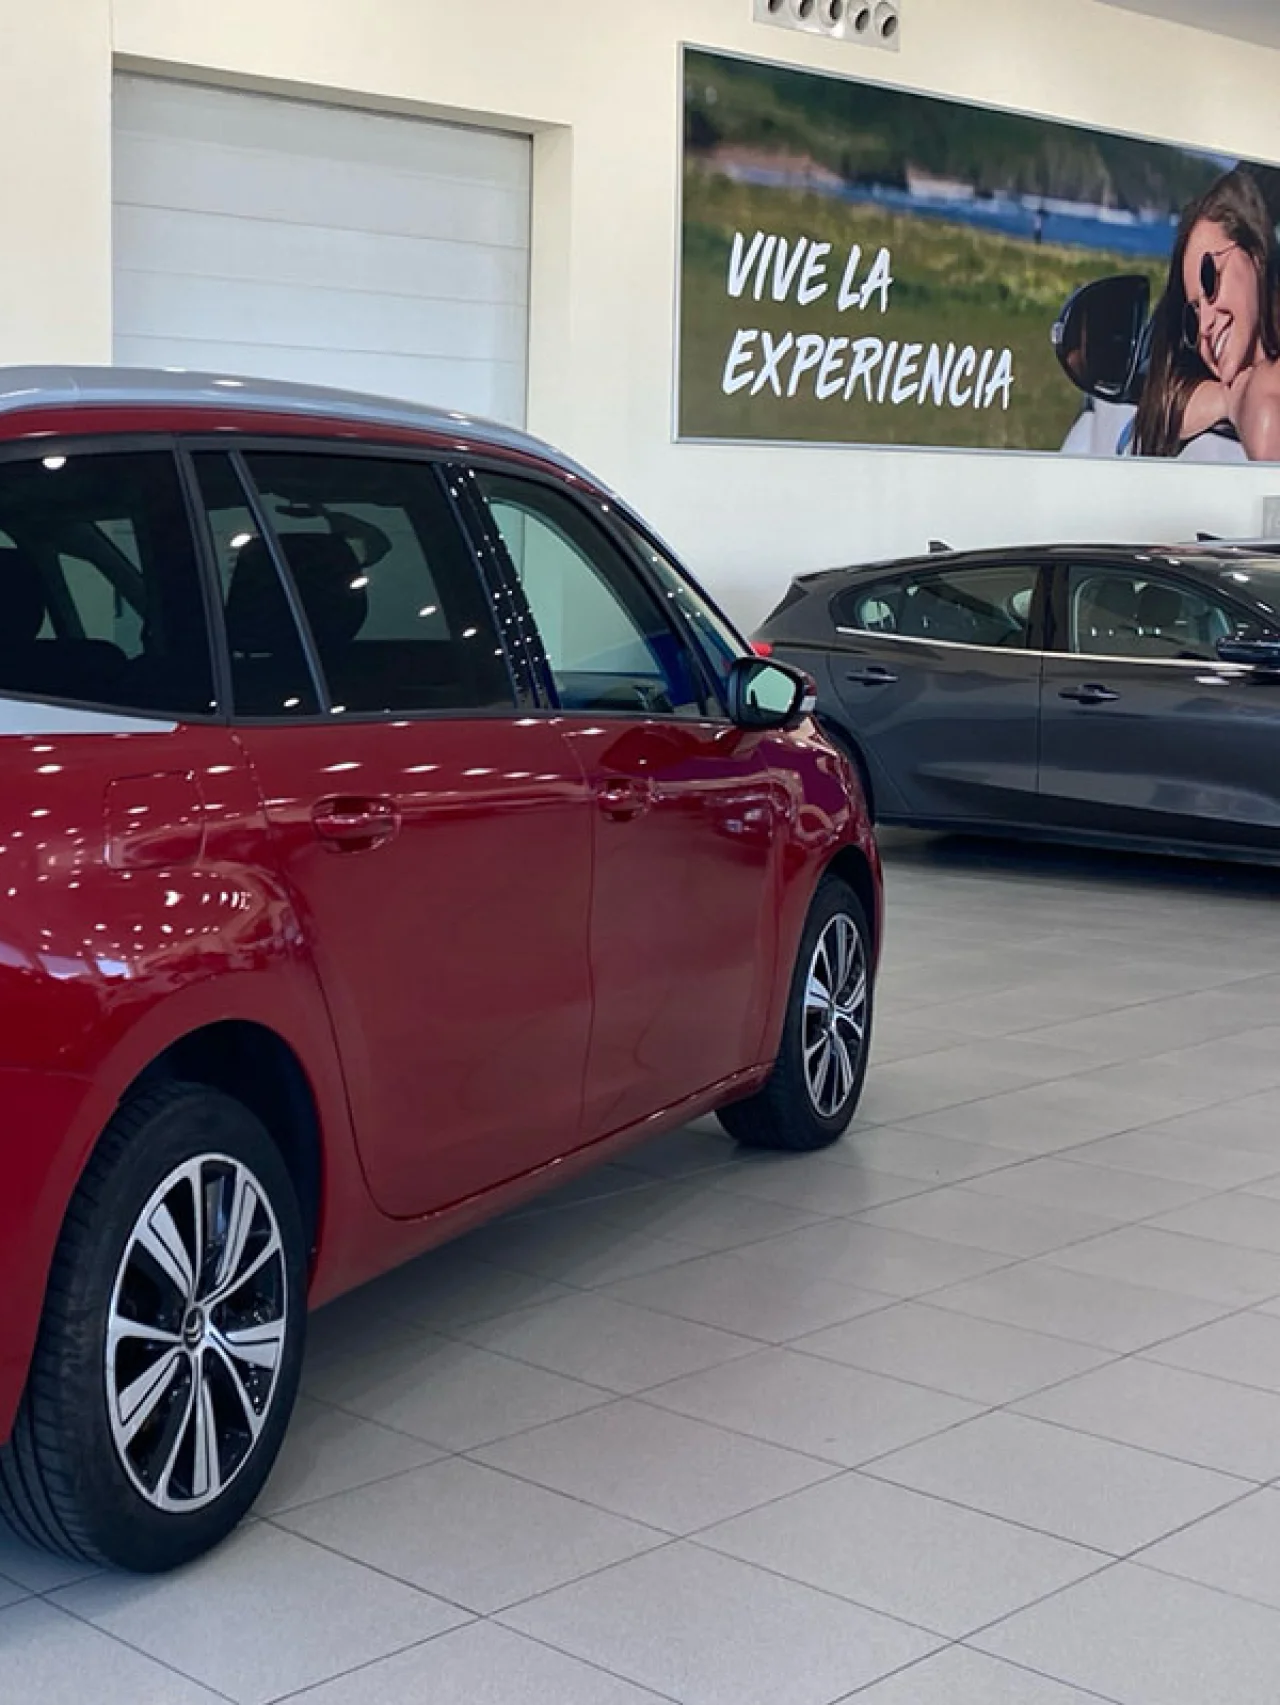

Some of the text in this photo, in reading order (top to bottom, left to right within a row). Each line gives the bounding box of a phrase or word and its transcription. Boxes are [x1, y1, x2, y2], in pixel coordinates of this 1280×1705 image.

[727, 231, 894, 313] VIVE LA
[722, 328, 1014, 410] EXPERIENCIA
